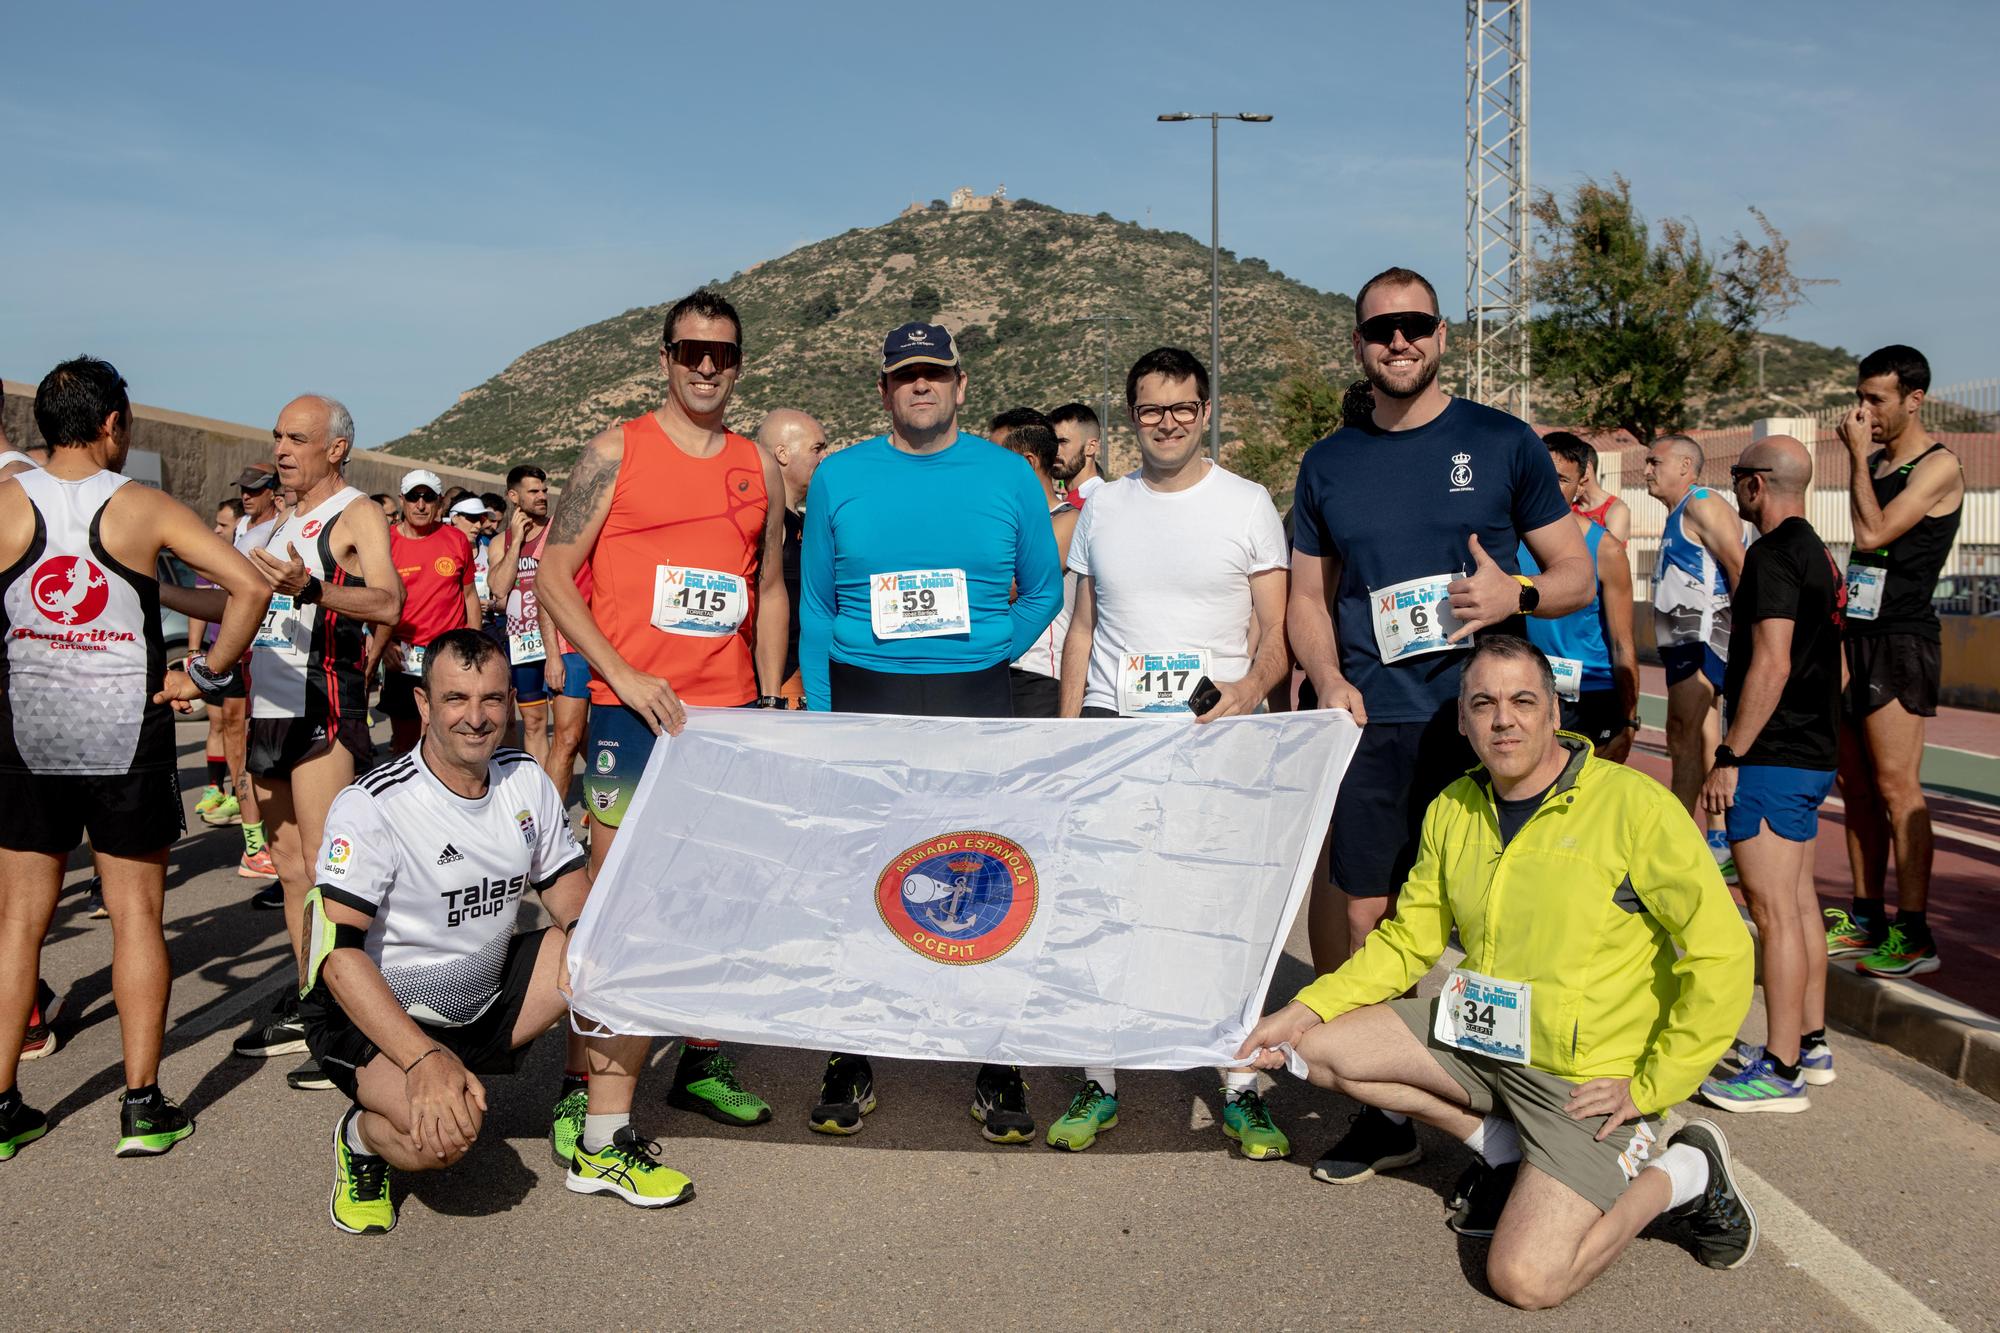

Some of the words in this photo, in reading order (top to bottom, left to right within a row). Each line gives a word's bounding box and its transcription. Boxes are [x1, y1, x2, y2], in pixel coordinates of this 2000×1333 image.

[665, 570, 684, 585] XI
[684, 577, 737, 593] CALVARIO
[880, 576, 897, 592] XI
[898, 578, 954, 591] CALVARIO
[678, 588, 726, 611] 115
[902, 589, 936, 611] 59
[1380, 594, 1395, 614] XI
[1410, 605, 1428, 627] 6
[11, 628, 136, 643] Runtriton
[50, 641, 107, 651] Cartagena
[520, 639, 543, 652] 103
[1128, 656, 1144, 671] XI
[1145, 659, 1200, 671] CALVARIO
[1140, 671, 1189, 692] 117
[437, 853, 464, 866] adidas
[896, 840, 959, 873] ARMADA
[447, 899, 503, 927] group
[912, 931, 975, 957] OCEPIT
[1450, 976, 1467, 995] XI
[1463, 986, 1517, 1010] CALVARIO
[1463, 1000, 1496, 1029] 34
